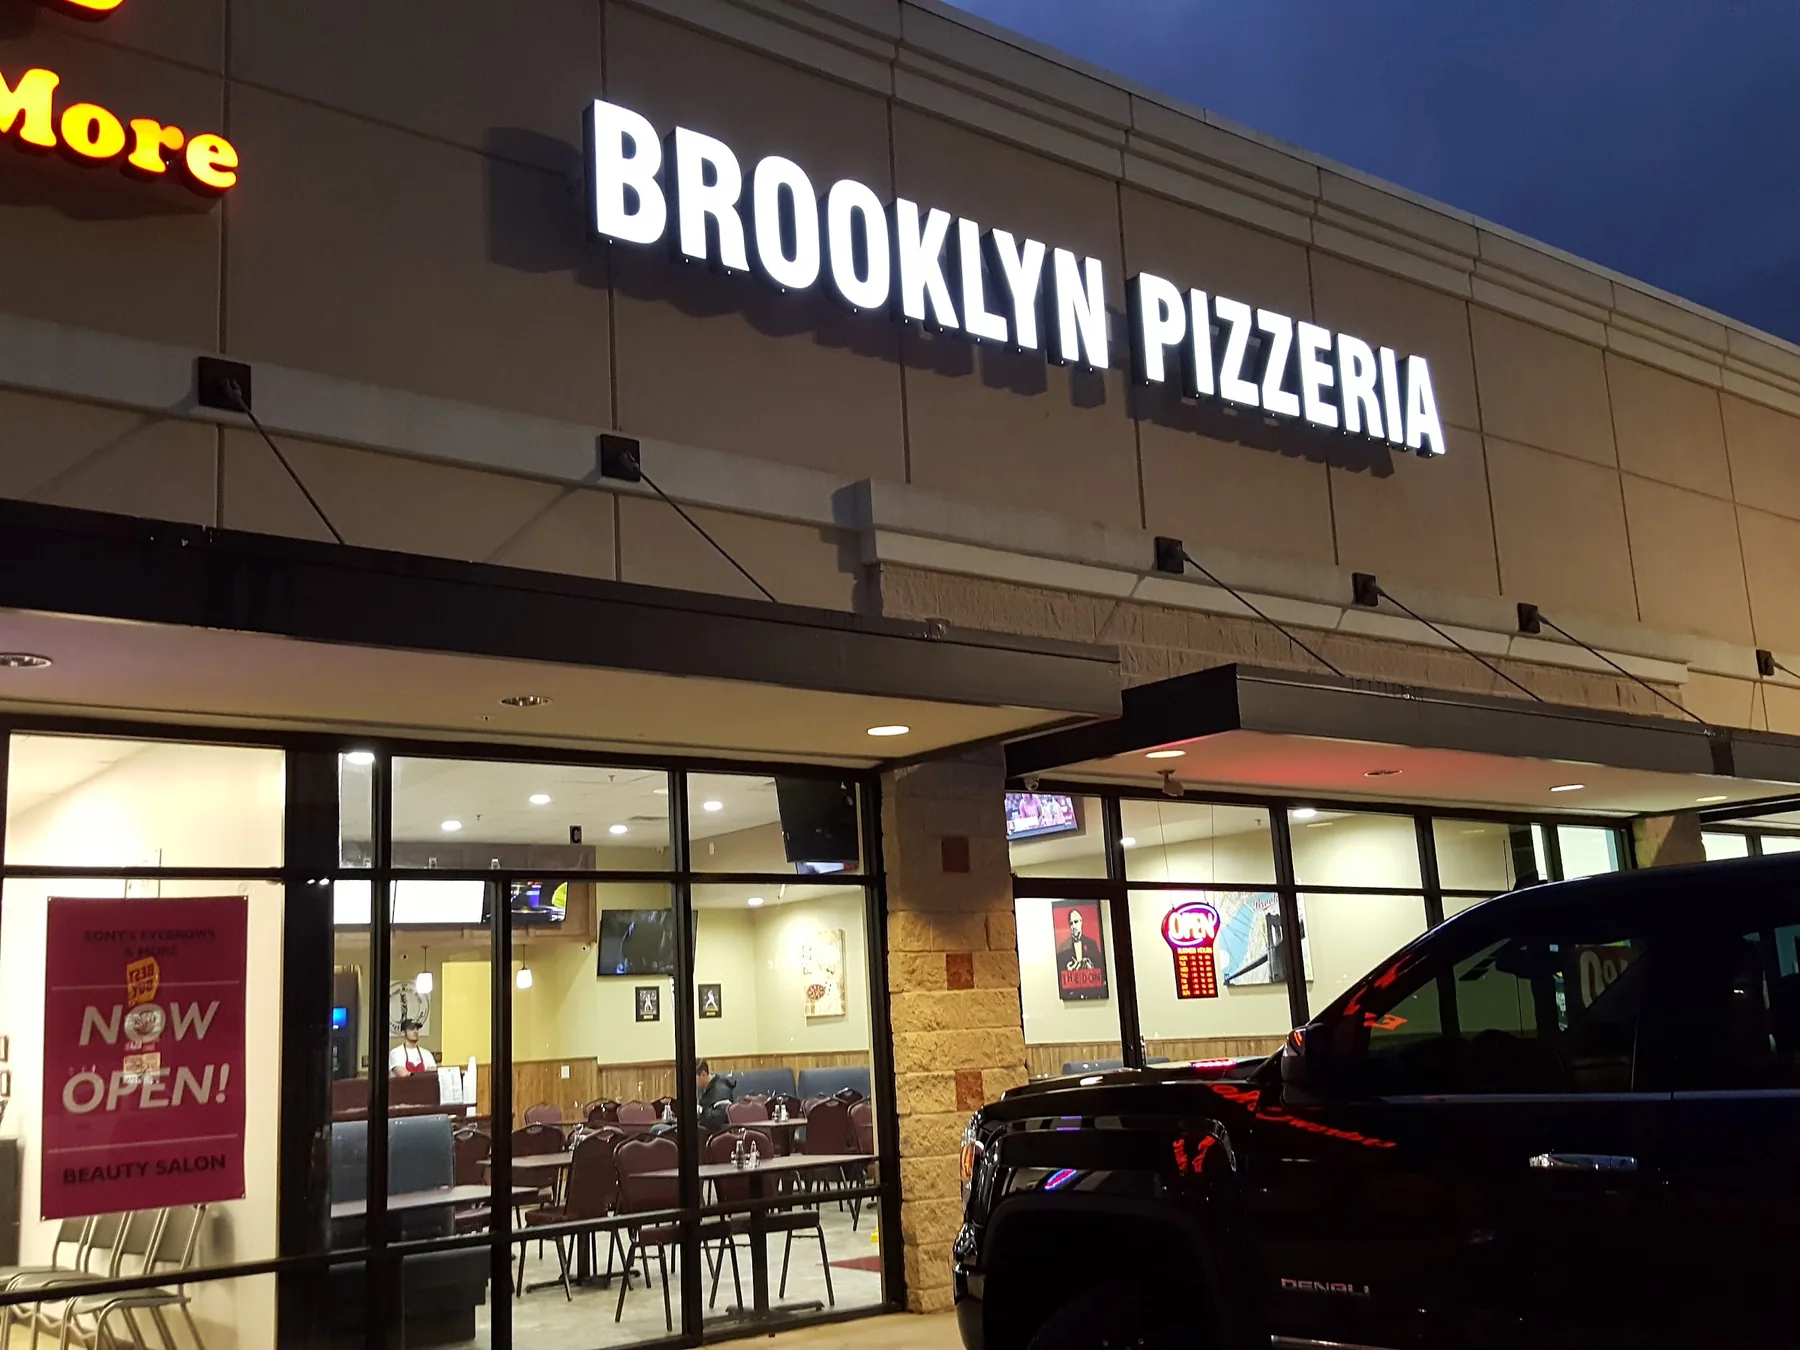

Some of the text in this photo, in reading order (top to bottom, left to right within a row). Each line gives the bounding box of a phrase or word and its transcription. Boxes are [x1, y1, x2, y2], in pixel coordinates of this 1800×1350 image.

[0, 67, 239, 188] More
[592, 99, 1446, 455] BROOKLYN PIZZERIA
[84, 928, 215, 942] SONY'S EYEBROWS
[1168, 911, 1215, 939] OPEN
[138, 946, 177, 957] MORE
[1062, 970, 1101, 986] THE DON
[79, 1001, 220, 1046] NOW
[63, 1063, 230, 1114] OPEN!
[63, 1154, 226, 1185] BEAUTY SALON
[1281, 1277, 1370, 1296] DENALI
